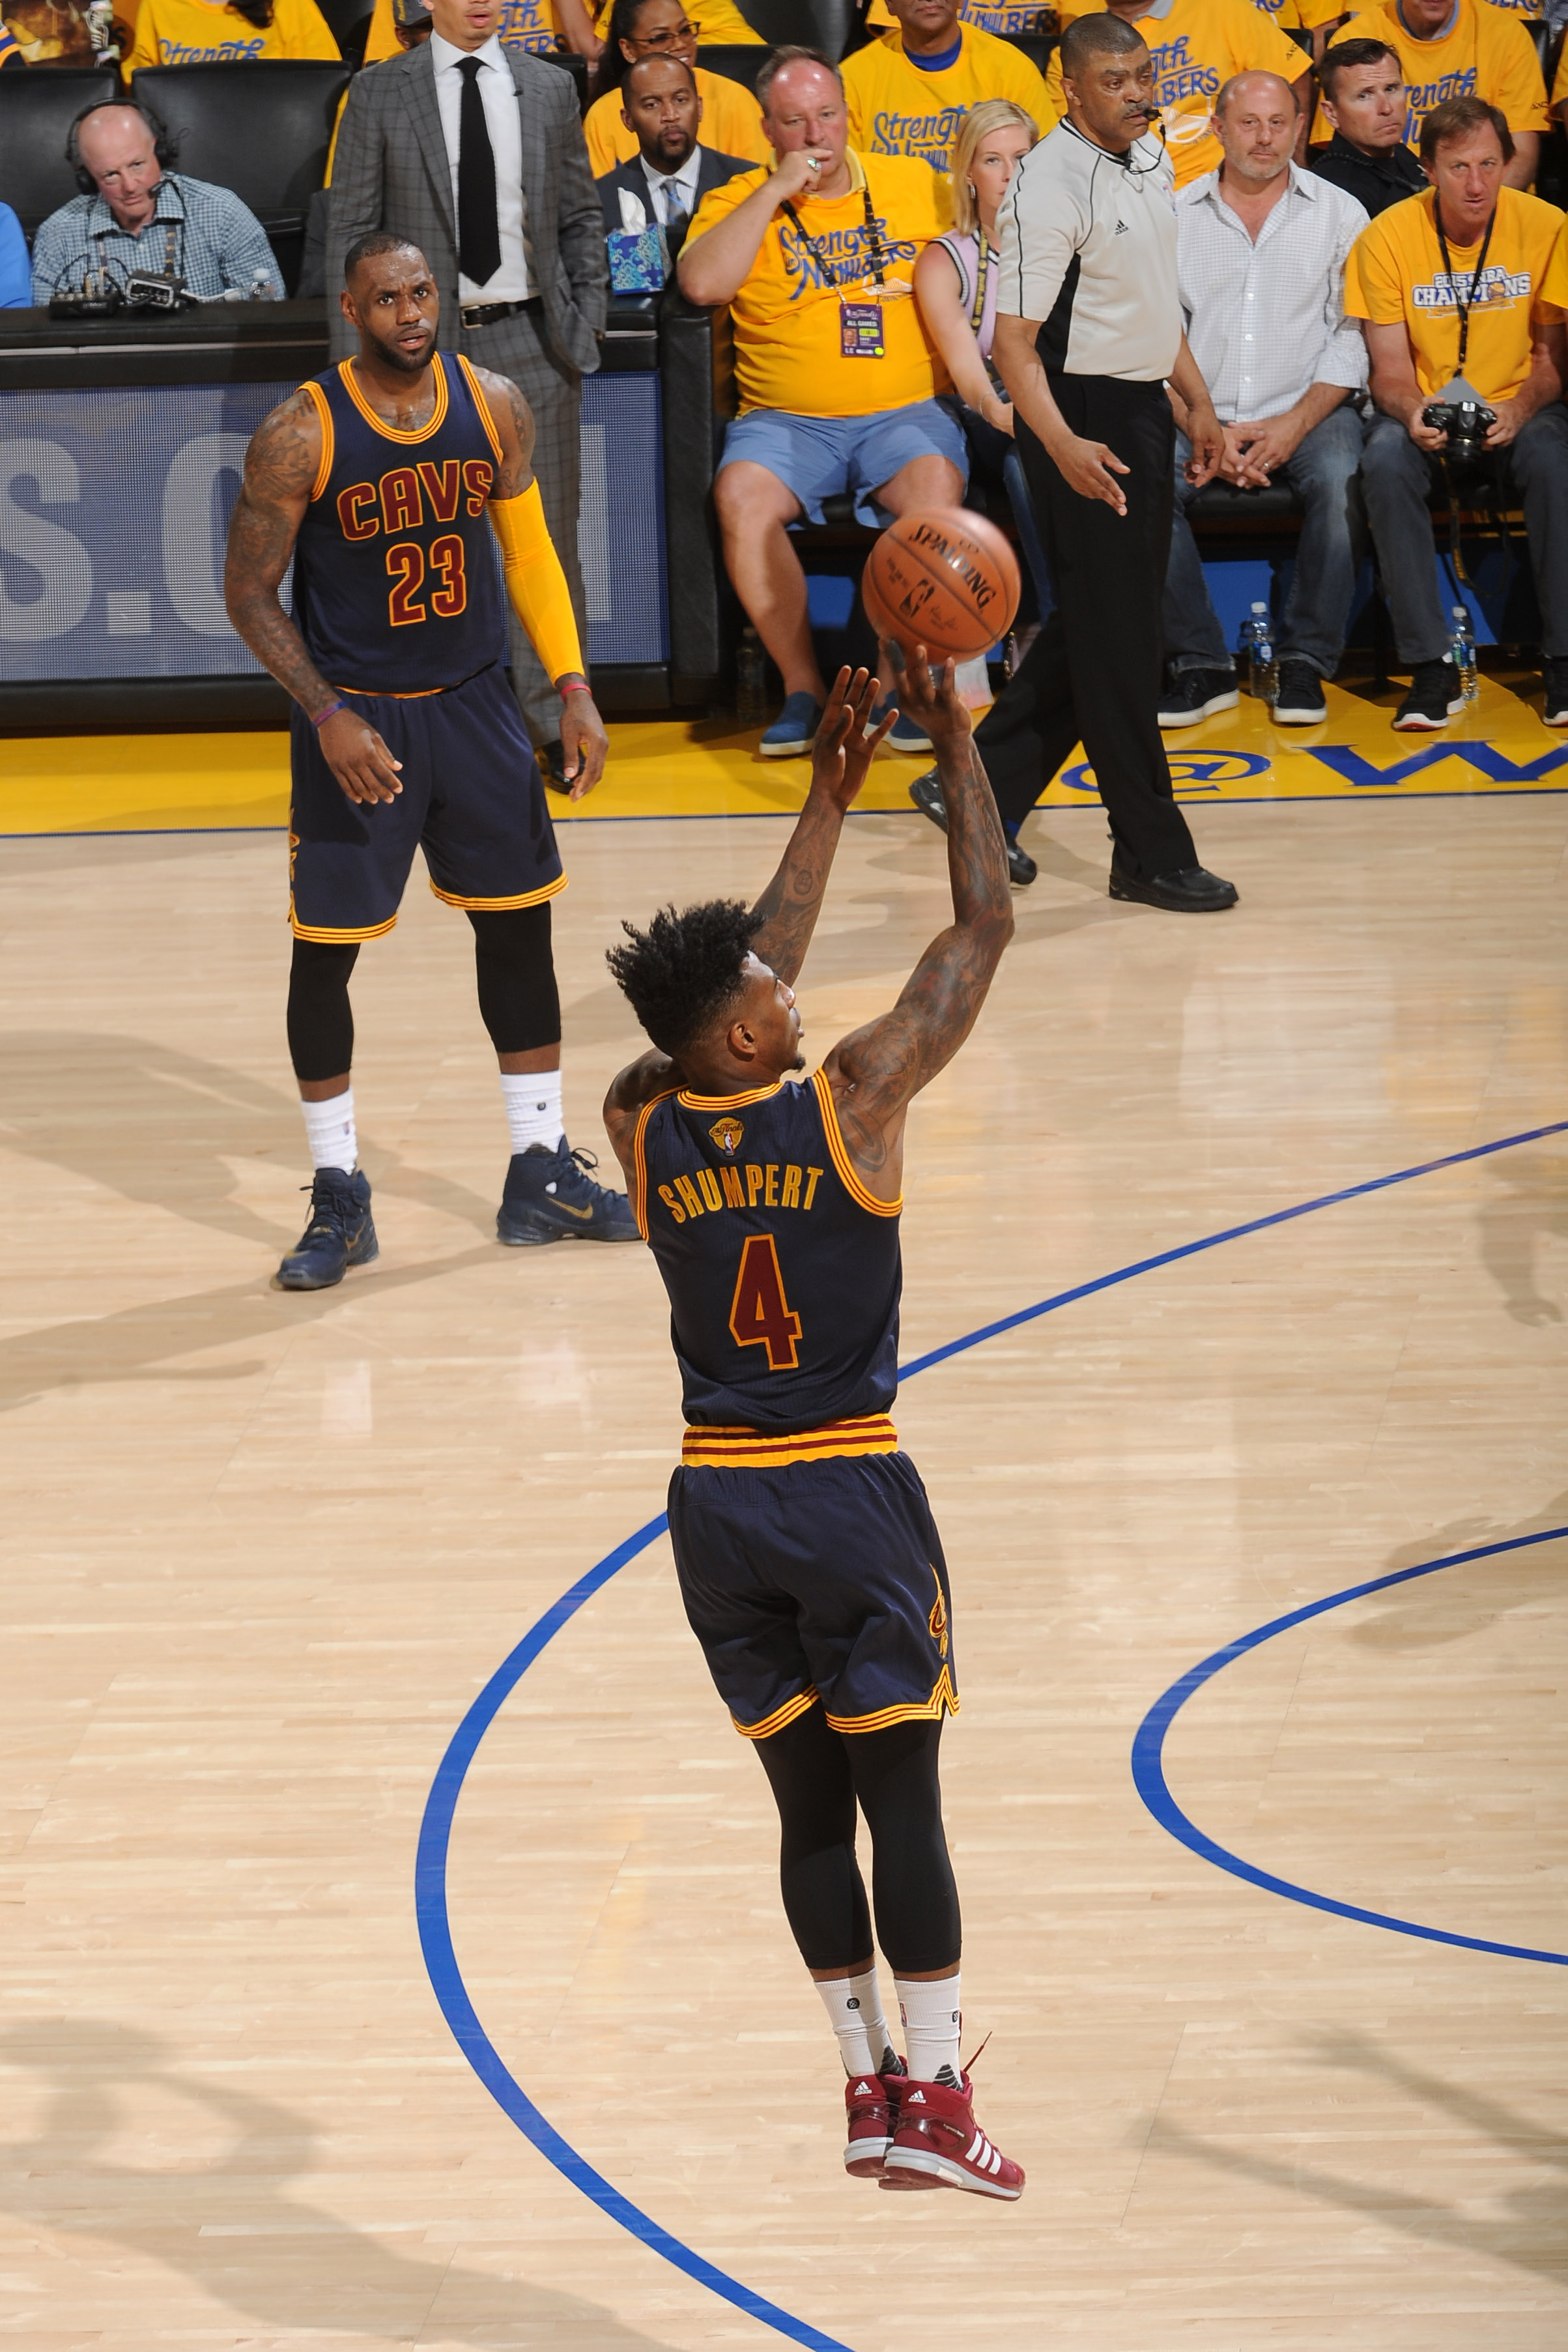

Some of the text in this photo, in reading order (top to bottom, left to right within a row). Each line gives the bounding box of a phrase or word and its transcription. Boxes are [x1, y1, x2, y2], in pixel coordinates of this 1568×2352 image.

[1153, 66, 1220, 108] BERS
[1434, 274, 1467, 289] 2015
[336, 459, 493, 541] CAVS
[386, 534, 467, 627] 23
[908, 524, 996, 597] SPALDING
[720, 1121, 743, 1136] Finals
[658, 1164, 824, 1224] SHUMPERT
[729, 1233, 803, 1370] 4
